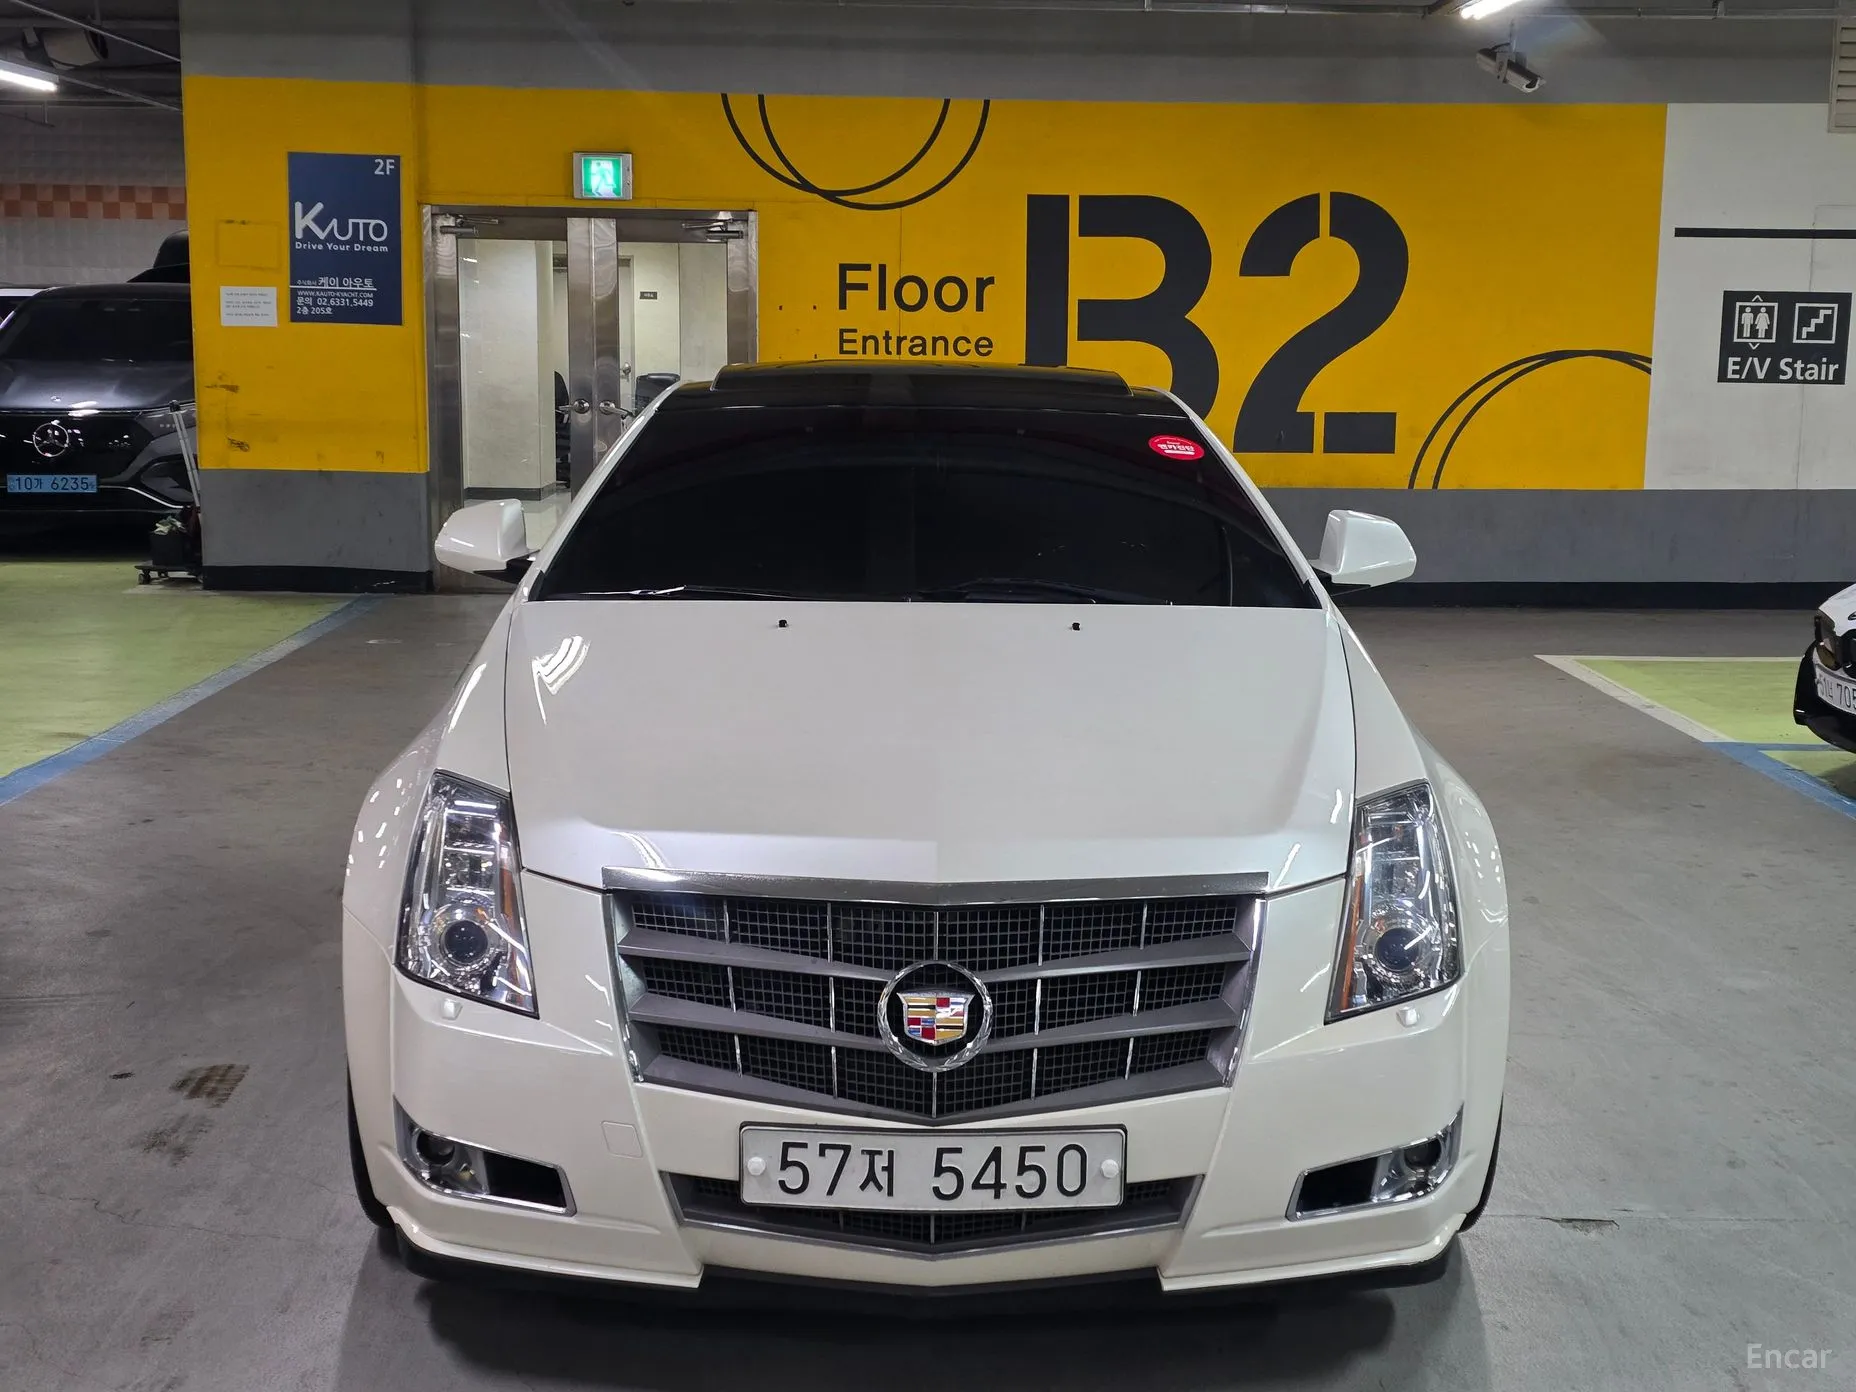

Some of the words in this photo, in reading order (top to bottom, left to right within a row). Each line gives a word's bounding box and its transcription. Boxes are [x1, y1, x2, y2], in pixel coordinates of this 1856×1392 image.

[374, 158, 395, 175] 2F
[295, 241, 323, 250] Drive
[326, 242, 350, 251] Your
[354, 243, 388, 252] Dream
[318, 277, 339, 288] 케이
[342, 277, 374, 288] 아우토
[838, 263, 995, 312] Floor
[296, 297, 313, 306] 문의
[317, 297, 374, 307] 02.6331.5449
[296, 306, 309, 315] 2층
[311, 306, 333, 315] 205호
[1025, 191, 1409, 454] B2
[838, 328, 994, 356] Entrance
[1727, 357, 1772, 379] E/V
[1779, 357, 1839, 380] Stair
[15, 477, 42, 490] 10가
[50, 477, 89, 490] 6235
[778, 1141, 895, 1197] 57저
[931, 1143, 1088, 1201] 5450
